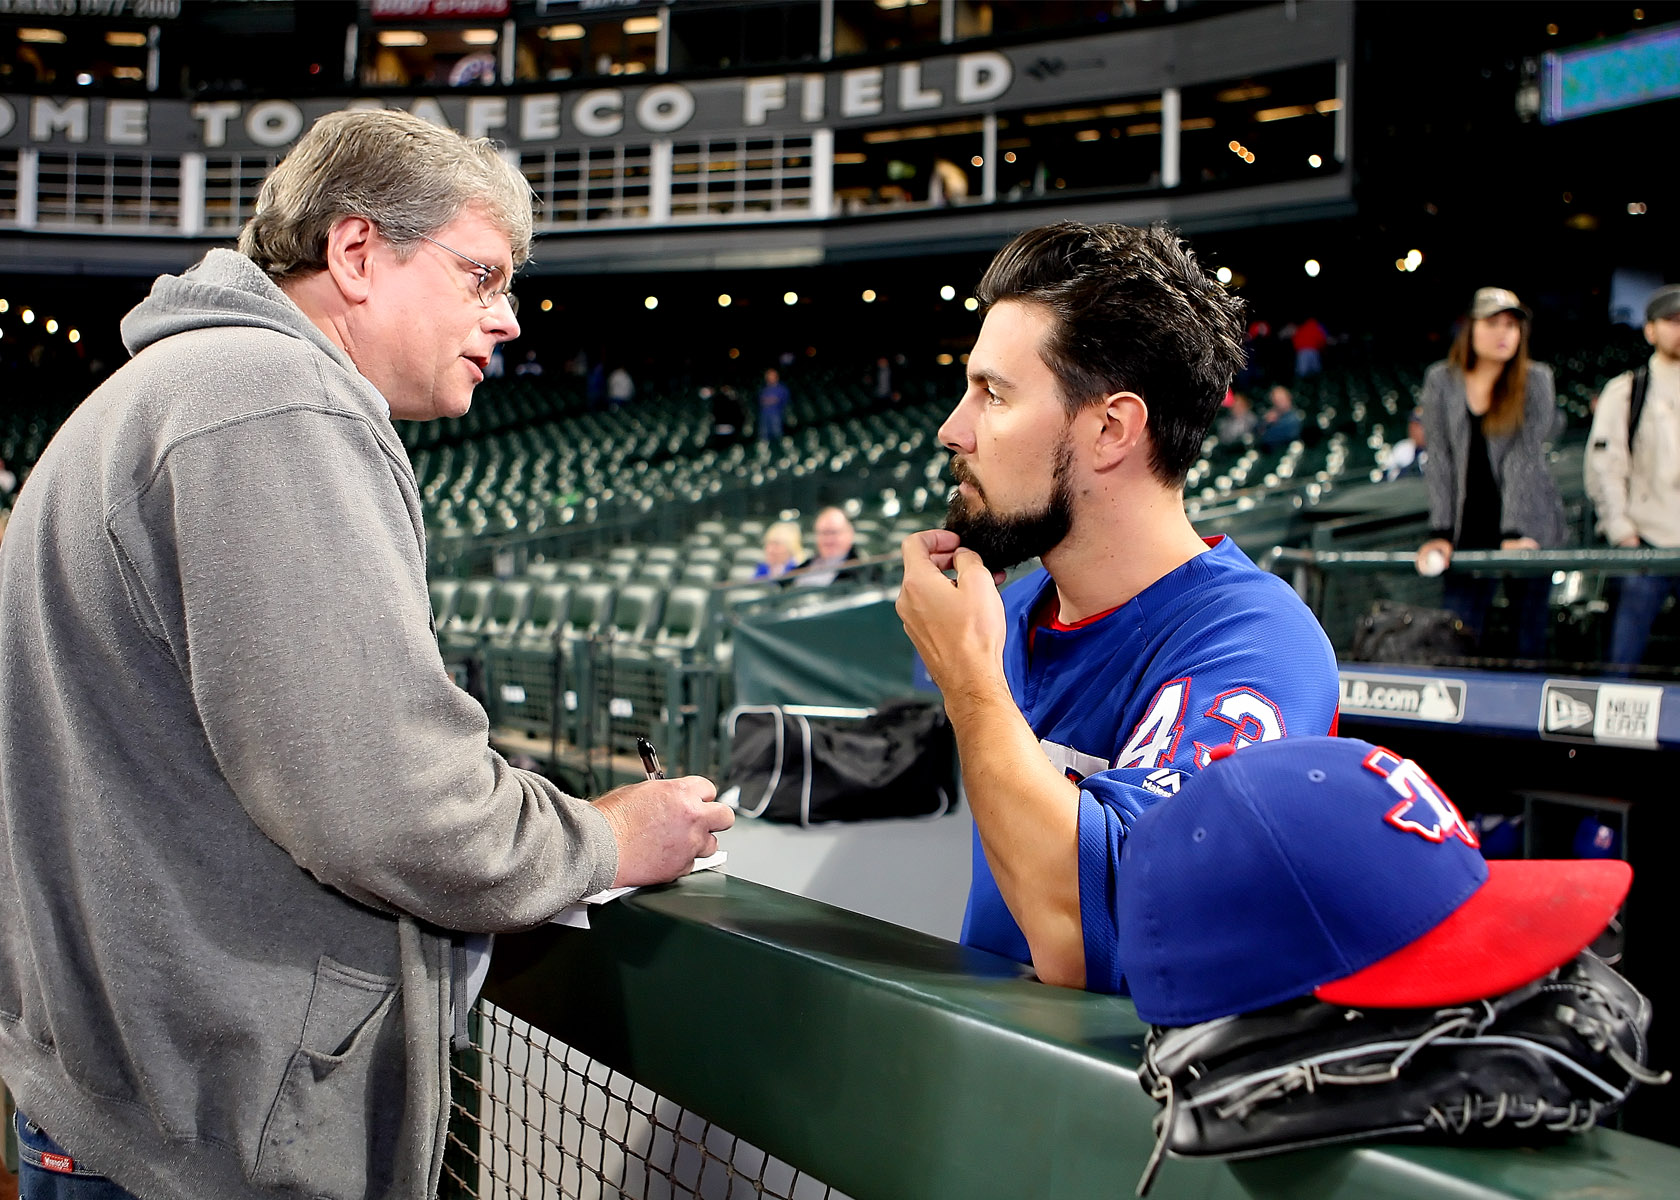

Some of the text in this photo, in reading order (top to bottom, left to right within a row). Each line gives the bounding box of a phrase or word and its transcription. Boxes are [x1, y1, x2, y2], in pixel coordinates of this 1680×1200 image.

[0, 51, 1013, 147] ME TO FECO FIELD
[1607, 698, 1650, 719] NEW
